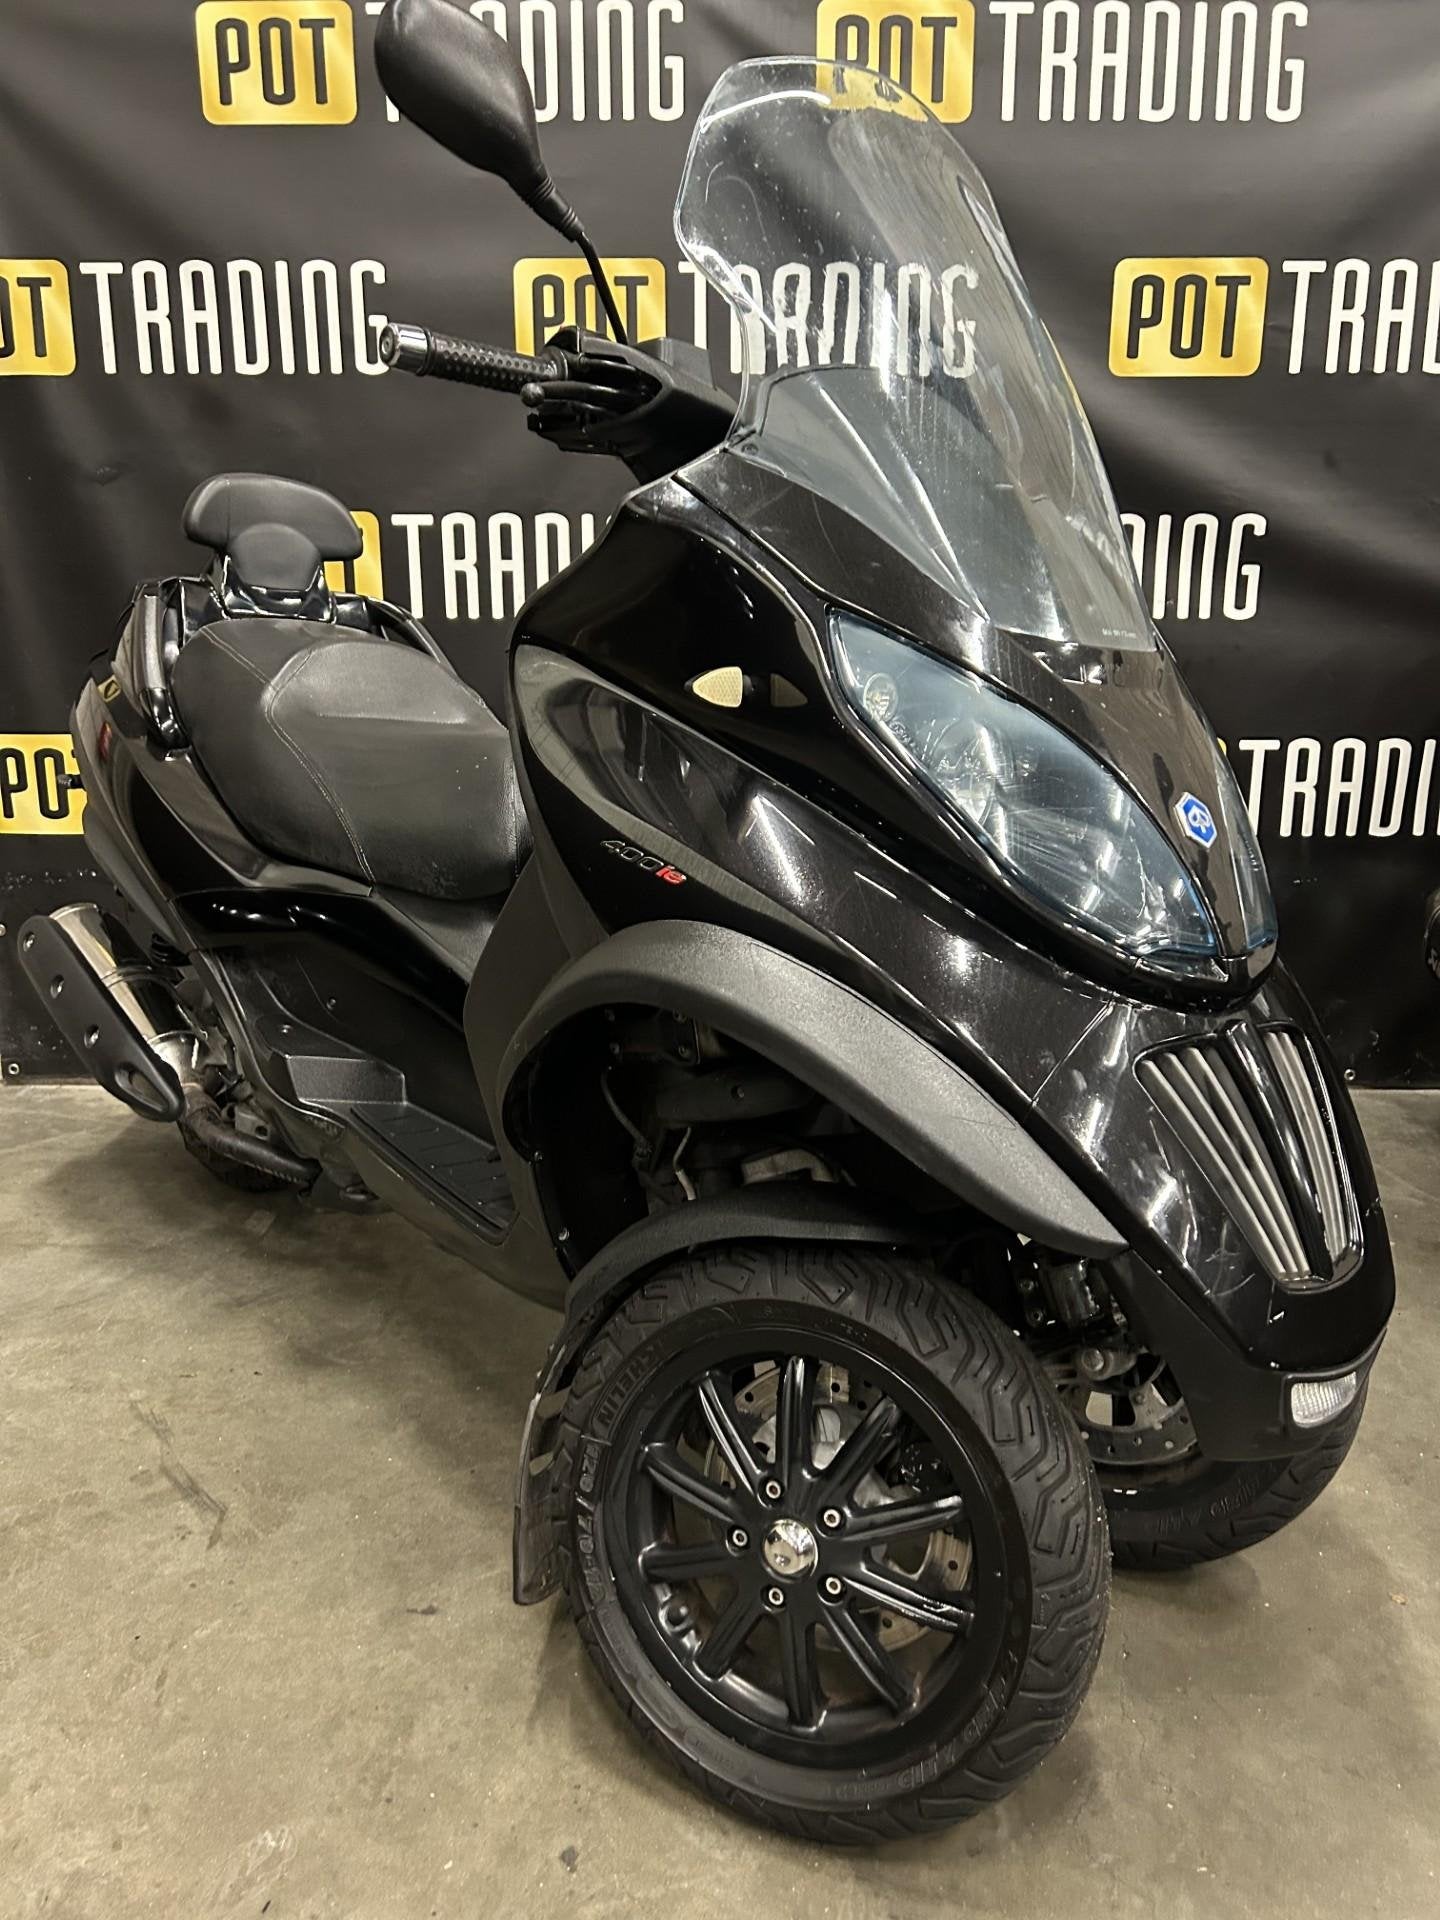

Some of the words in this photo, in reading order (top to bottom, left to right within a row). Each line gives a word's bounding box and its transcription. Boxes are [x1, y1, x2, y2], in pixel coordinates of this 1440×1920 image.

[215, 17, 336, 106] POT
[365, 0, 685, 122] DING
[833, 14, 957, 104] POT
[989, 0, 1308, 122] TRADING
[79, 260, 391, 375] TRADING
[1126, 273, 1251, 359] POT
[390, 511, 612, 620] TRAD
[0, 748, 76, 819] PO
[1238, 737, 1440, 838] TRADI
